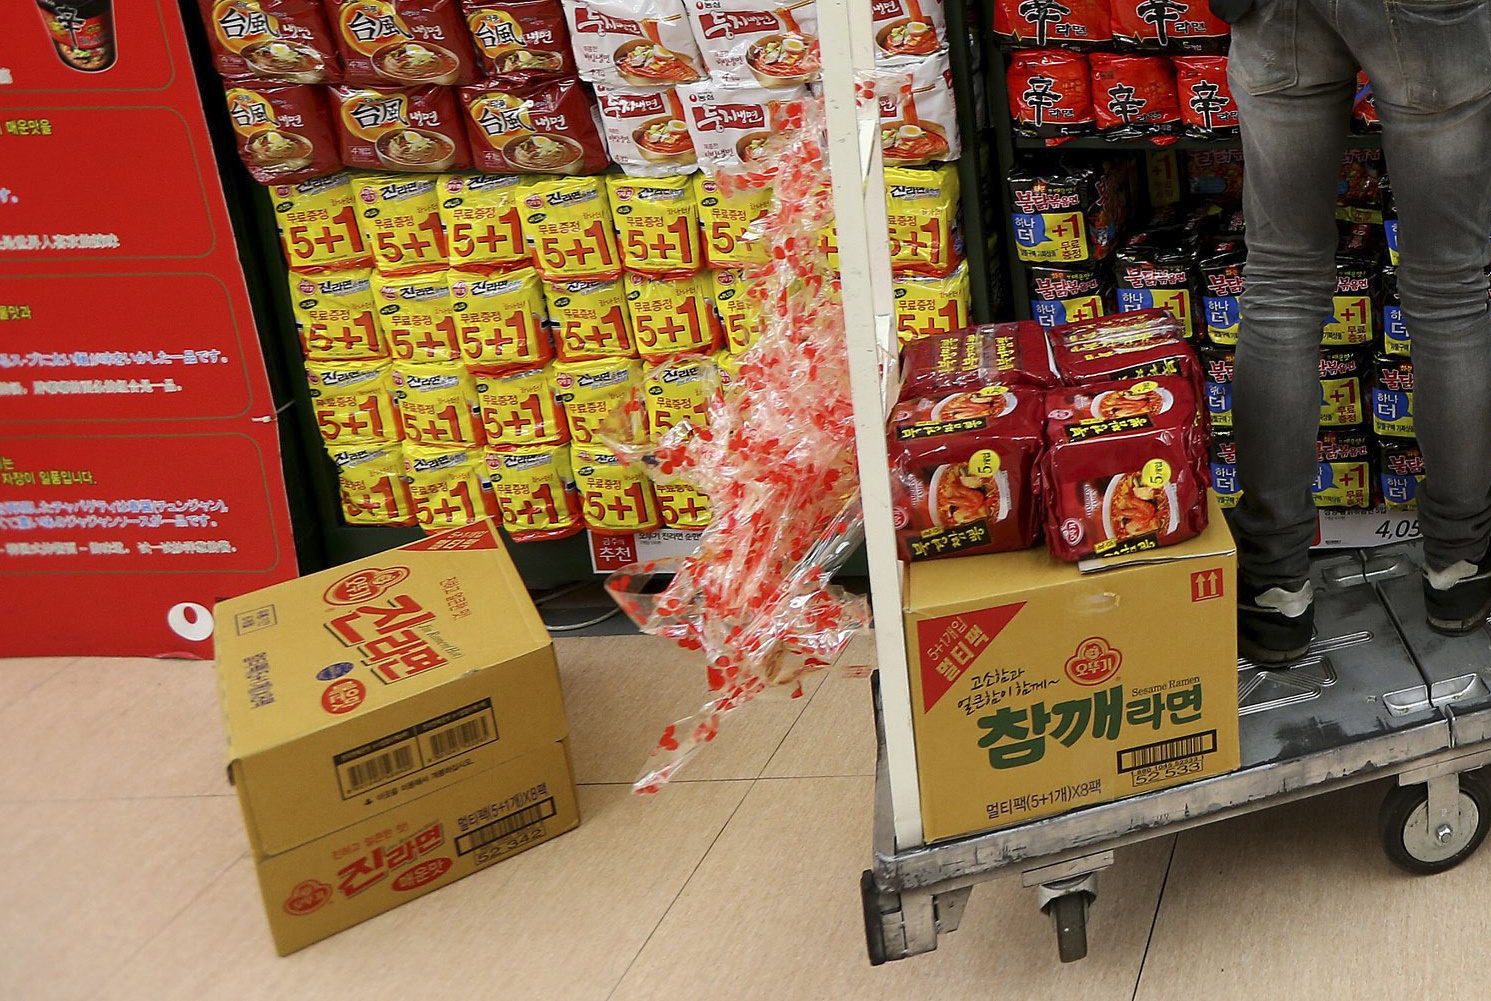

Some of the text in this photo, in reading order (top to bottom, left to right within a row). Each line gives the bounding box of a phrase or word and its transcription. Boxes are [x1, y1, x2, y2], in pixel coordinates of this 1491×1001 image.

[703, 11, 778, 41] 둥지냉면
[1015, 190, 1080, 213] 불닭볶음면
[286, 211, 328, 224] 무료증정
[1015, 217, 1035, 228] 하나
[1052, 214, 1080, 239] +1
[291, 206, 364, 258] 5+1
[538, 220, 613, 269] 5+1
[1017, 229, 1035, 243] 더
[585, 483, 648, 523] 5+1
[599, 547, 632, 562] 추천
[328, 594, 449, 686] 진라면
[926, 617, 967, 662] 5+1개입
[935, 623, 990, 683] 멀티팩
[970, 667, 1025, 691] 고소함과
[1075, 656, 1113, 678] 오뚜기
[1132, 675, 1201, 697] Sesame Ramen
[977, 684, 1203, 770] 참깨라면
[1134, 761, 1202, 785] 52 533
[337, 823, 446, 898] 진라면
